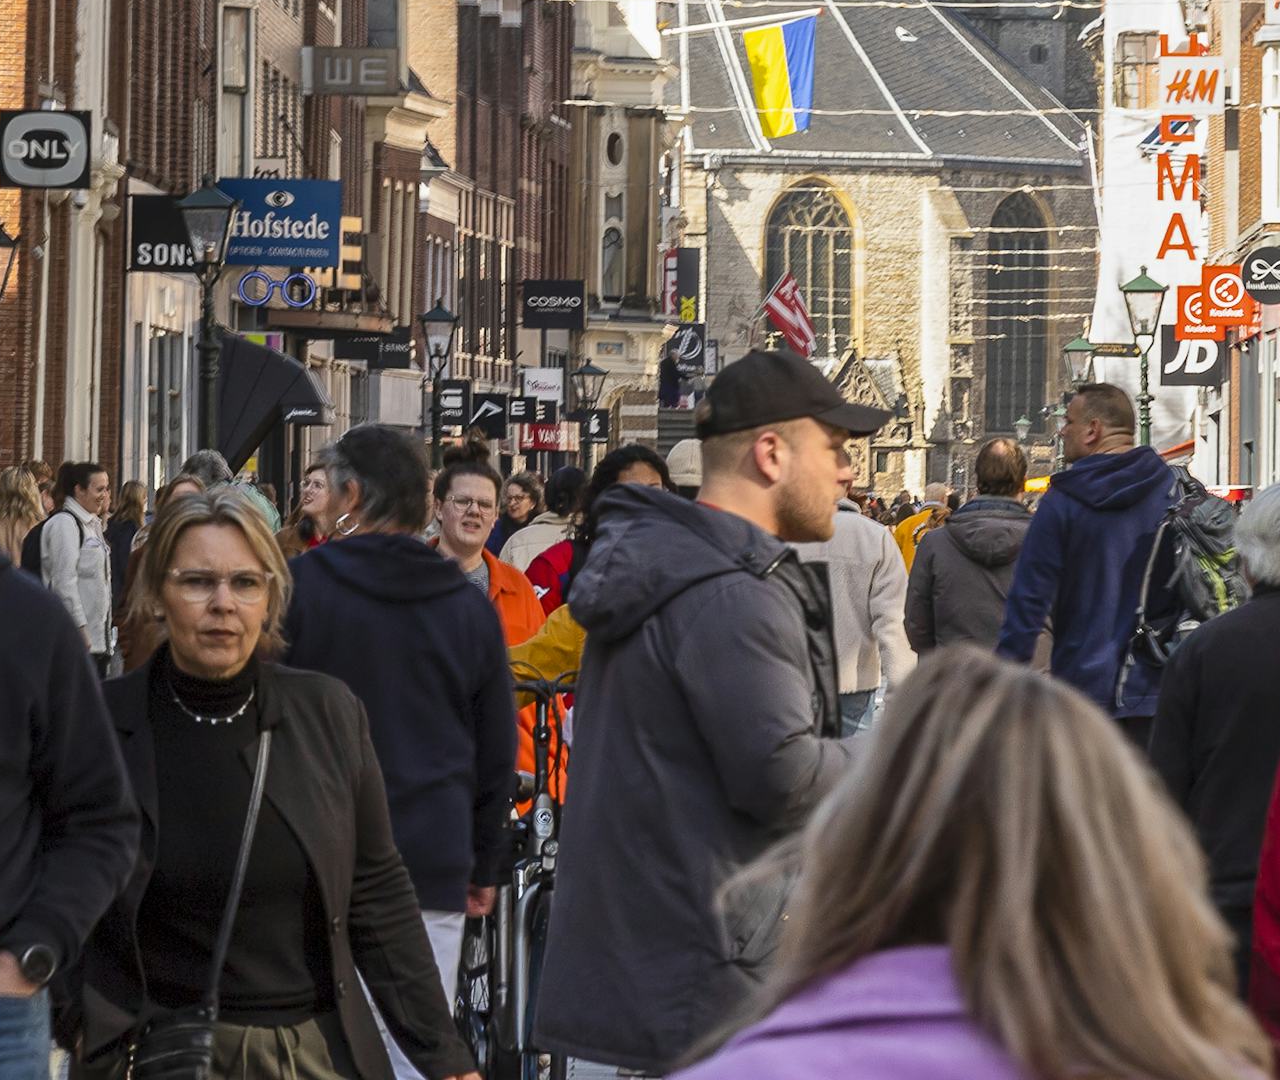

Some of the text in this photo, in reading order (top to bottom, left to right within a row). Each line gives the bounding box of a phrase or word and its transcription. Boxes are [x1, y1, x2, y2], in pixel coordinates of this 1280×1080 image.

[324, 56, 386, 86] WE
[1167, 69, 1219, 104] H&M
[8, 139, 80, 160] ONLY
[230, 210, 330, 240] Hofstede
[527, 296, 581, 307] COSMO
[1164, 339, 1218, 375] JD
